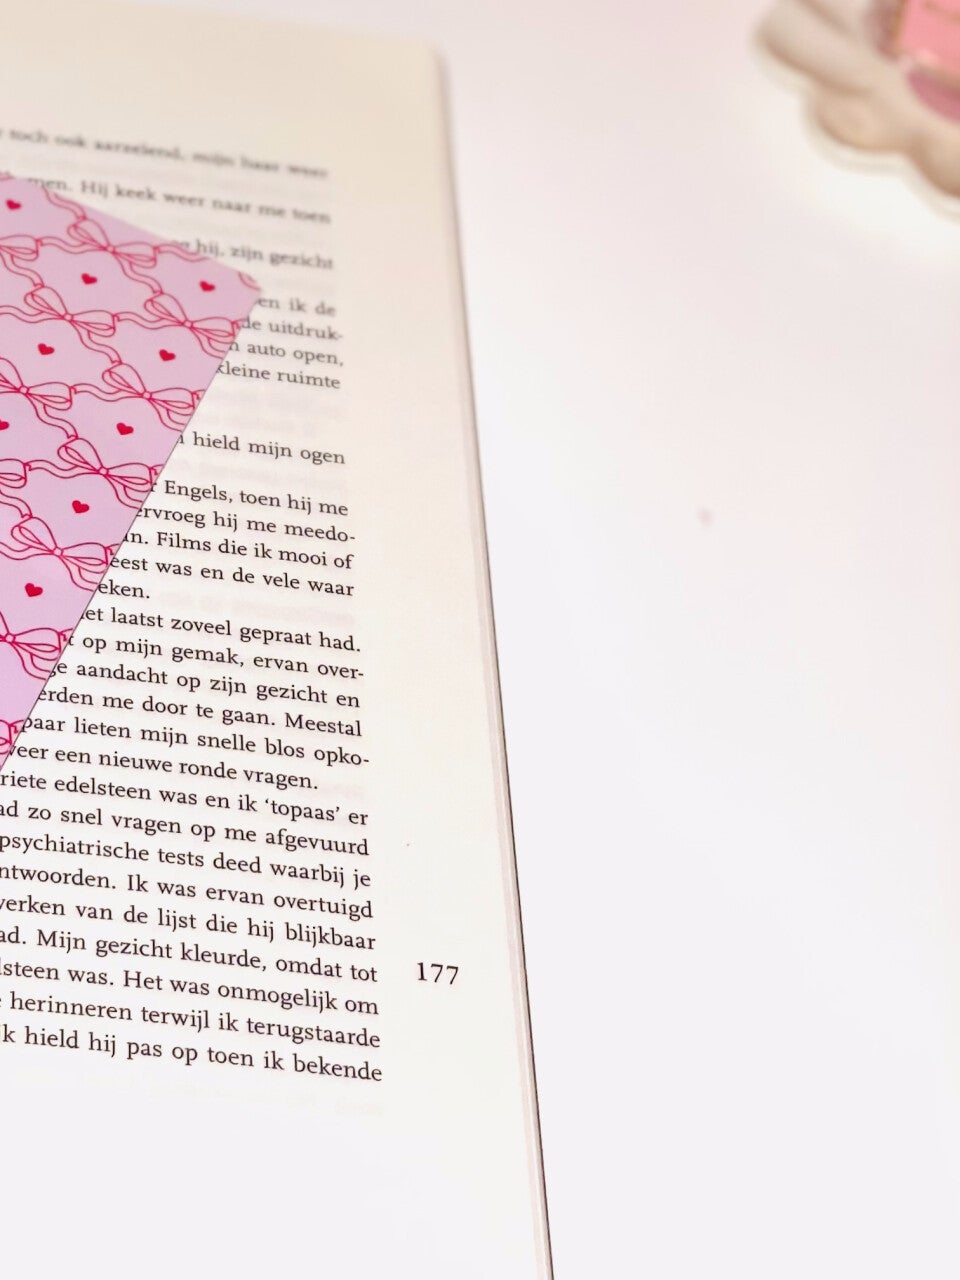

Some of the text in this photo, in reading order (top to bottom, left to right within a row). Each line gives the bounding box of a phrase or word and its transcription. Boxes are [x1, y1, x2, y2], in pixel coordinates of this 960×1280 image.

[229, 242, 264, 263] zijn
[267, 250, 335, 271] gezicht
[192, 430, 346, 466] hield mijn ogen
[164, 479, 349, 517] Engels, toen hij me
[155, 562, 355, 597] was en de vele waar
[76, 663, 361, 708] aandacht op zijn gezicht en
[54, 749, 318, 791] een nieuwe ronde vragen.
[157, 848, 205, 868] tests
[212, 851, 263, 874] deed
[269, 863, 345, 889] waarbij
[353, 868, 371, 891] je
[36, 928, 87, 954] Mijn
[95, 938, 173, 959] gezicht
[180, 941, 267, 972] kleurde,
[275, 957, 343, 978] omdat
[350, 964, 378, 983] tot
[417, 961, 459, 985] 177
[24, 1025, 80, 1049] hield
[88, 1031, 116, 1058] hij
[126, 1041, 163, 1061] pas
[171, 1046, 198, 1066] op
[207, 1046, 255, 1067] toen
[263, 1050, 285, 1071] ik
[292, 1052, 383, 1082] bekende
